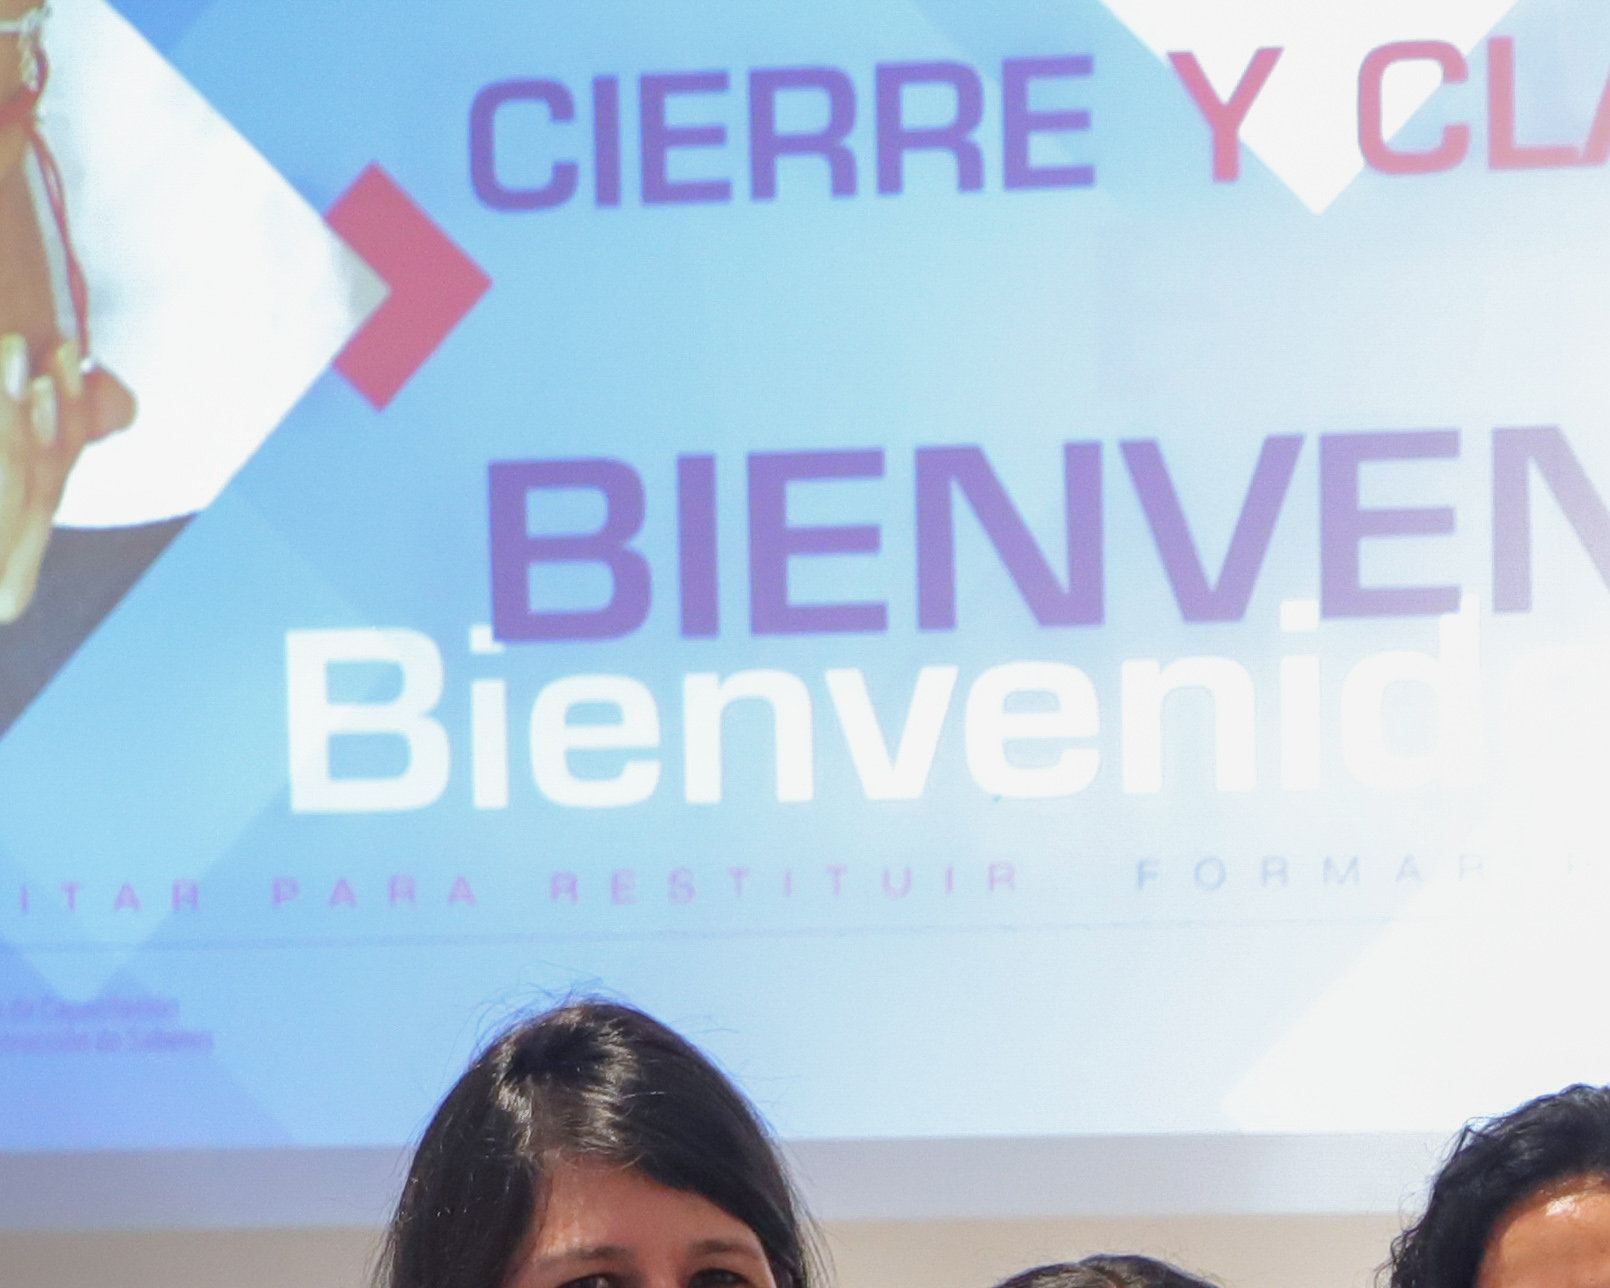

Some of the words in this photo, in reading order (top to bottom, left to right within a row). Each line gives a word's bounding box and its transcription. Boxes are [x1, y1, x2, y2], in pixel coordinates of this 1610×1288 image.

[466, 54, 1097, 213] CIERRE
[1167, 46, 1284, 182] Y
[284, 592, 1520, 815] Bienvenid
[271, 876, 478, 911] PARA
[550, 862, 1019, 904] RESTITUIR
[1135, 852, 1486, 892] FORMAR
